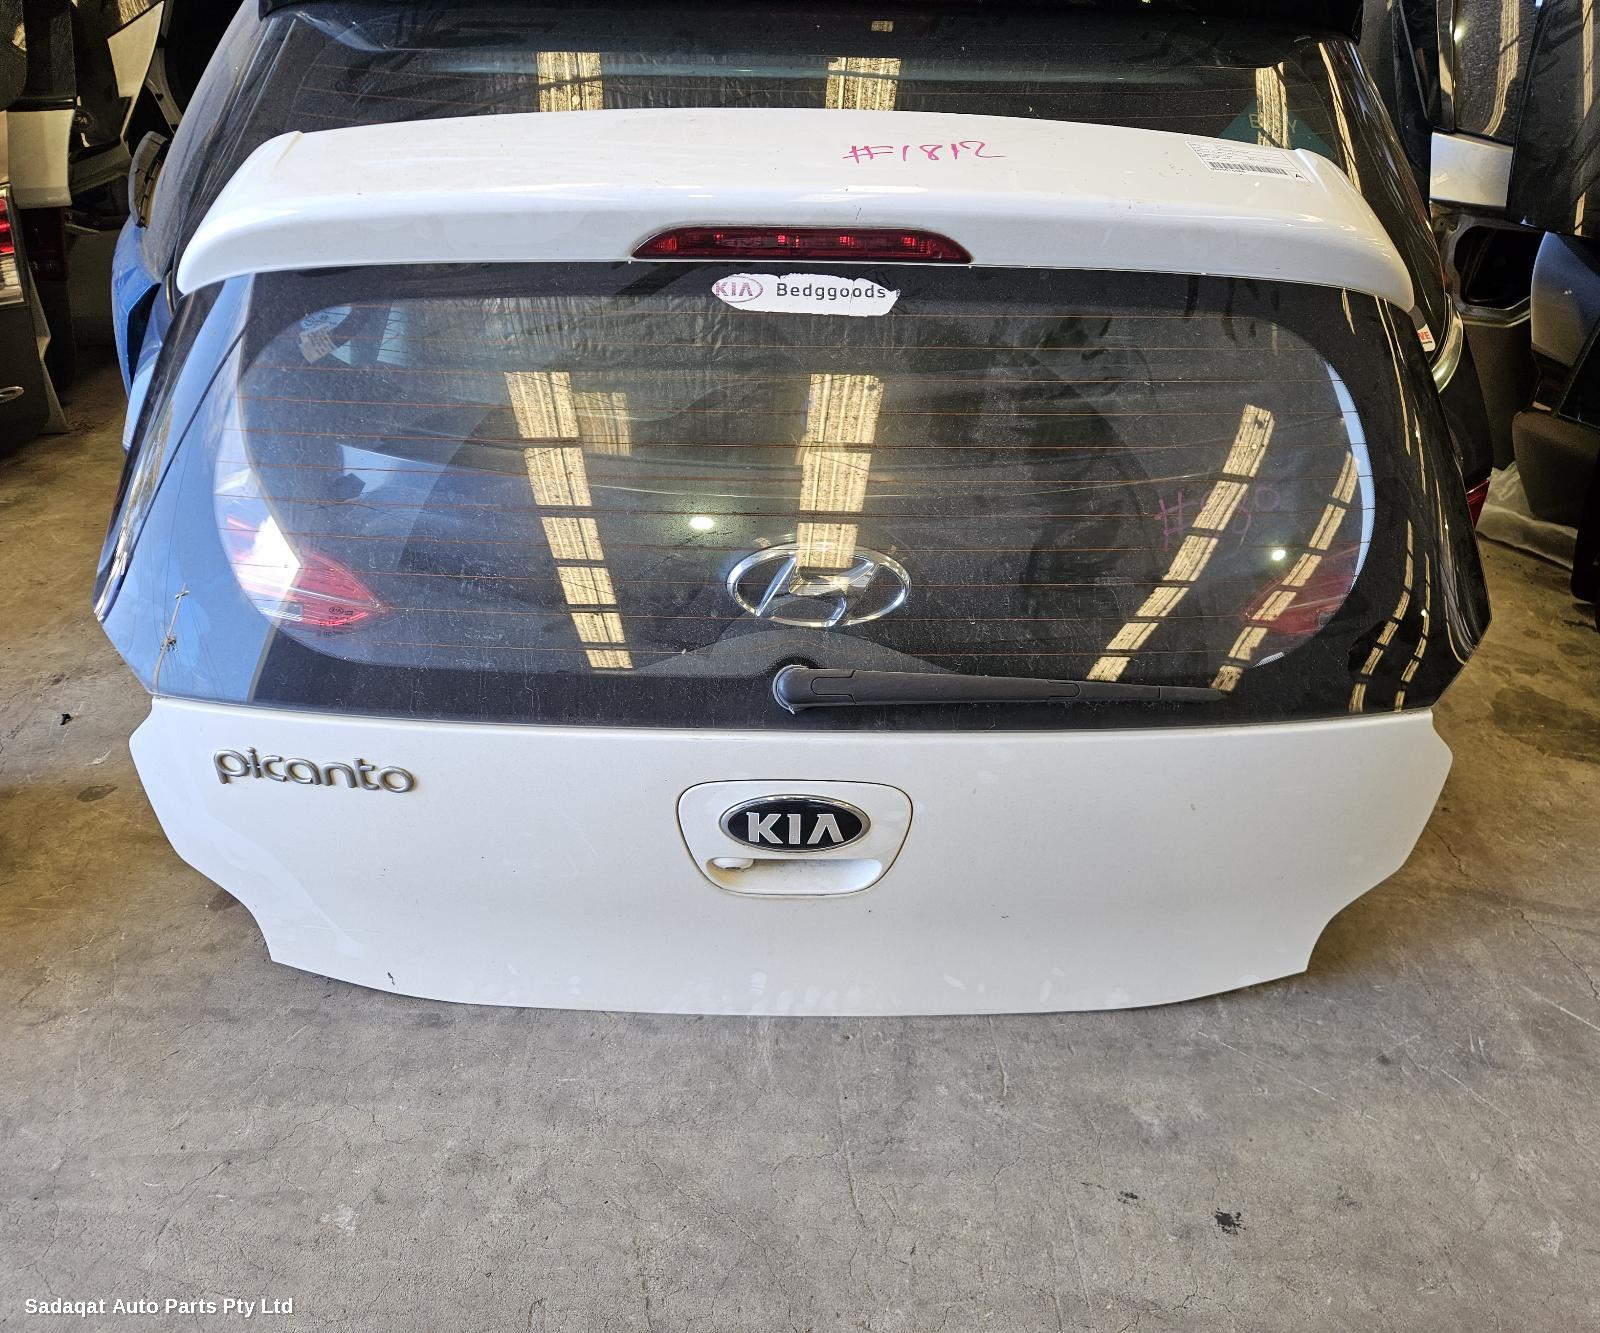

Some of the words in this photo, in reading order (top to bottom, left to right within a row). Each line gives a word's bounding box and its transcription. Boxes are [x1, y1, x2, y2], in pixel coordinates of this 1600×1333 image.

[715, 282, 753, 297] KIA
[776, 283, 886, 300] Bedggoods
[214, 747, 415, 793] picanto
[746, 811, 845, 845] KIA
